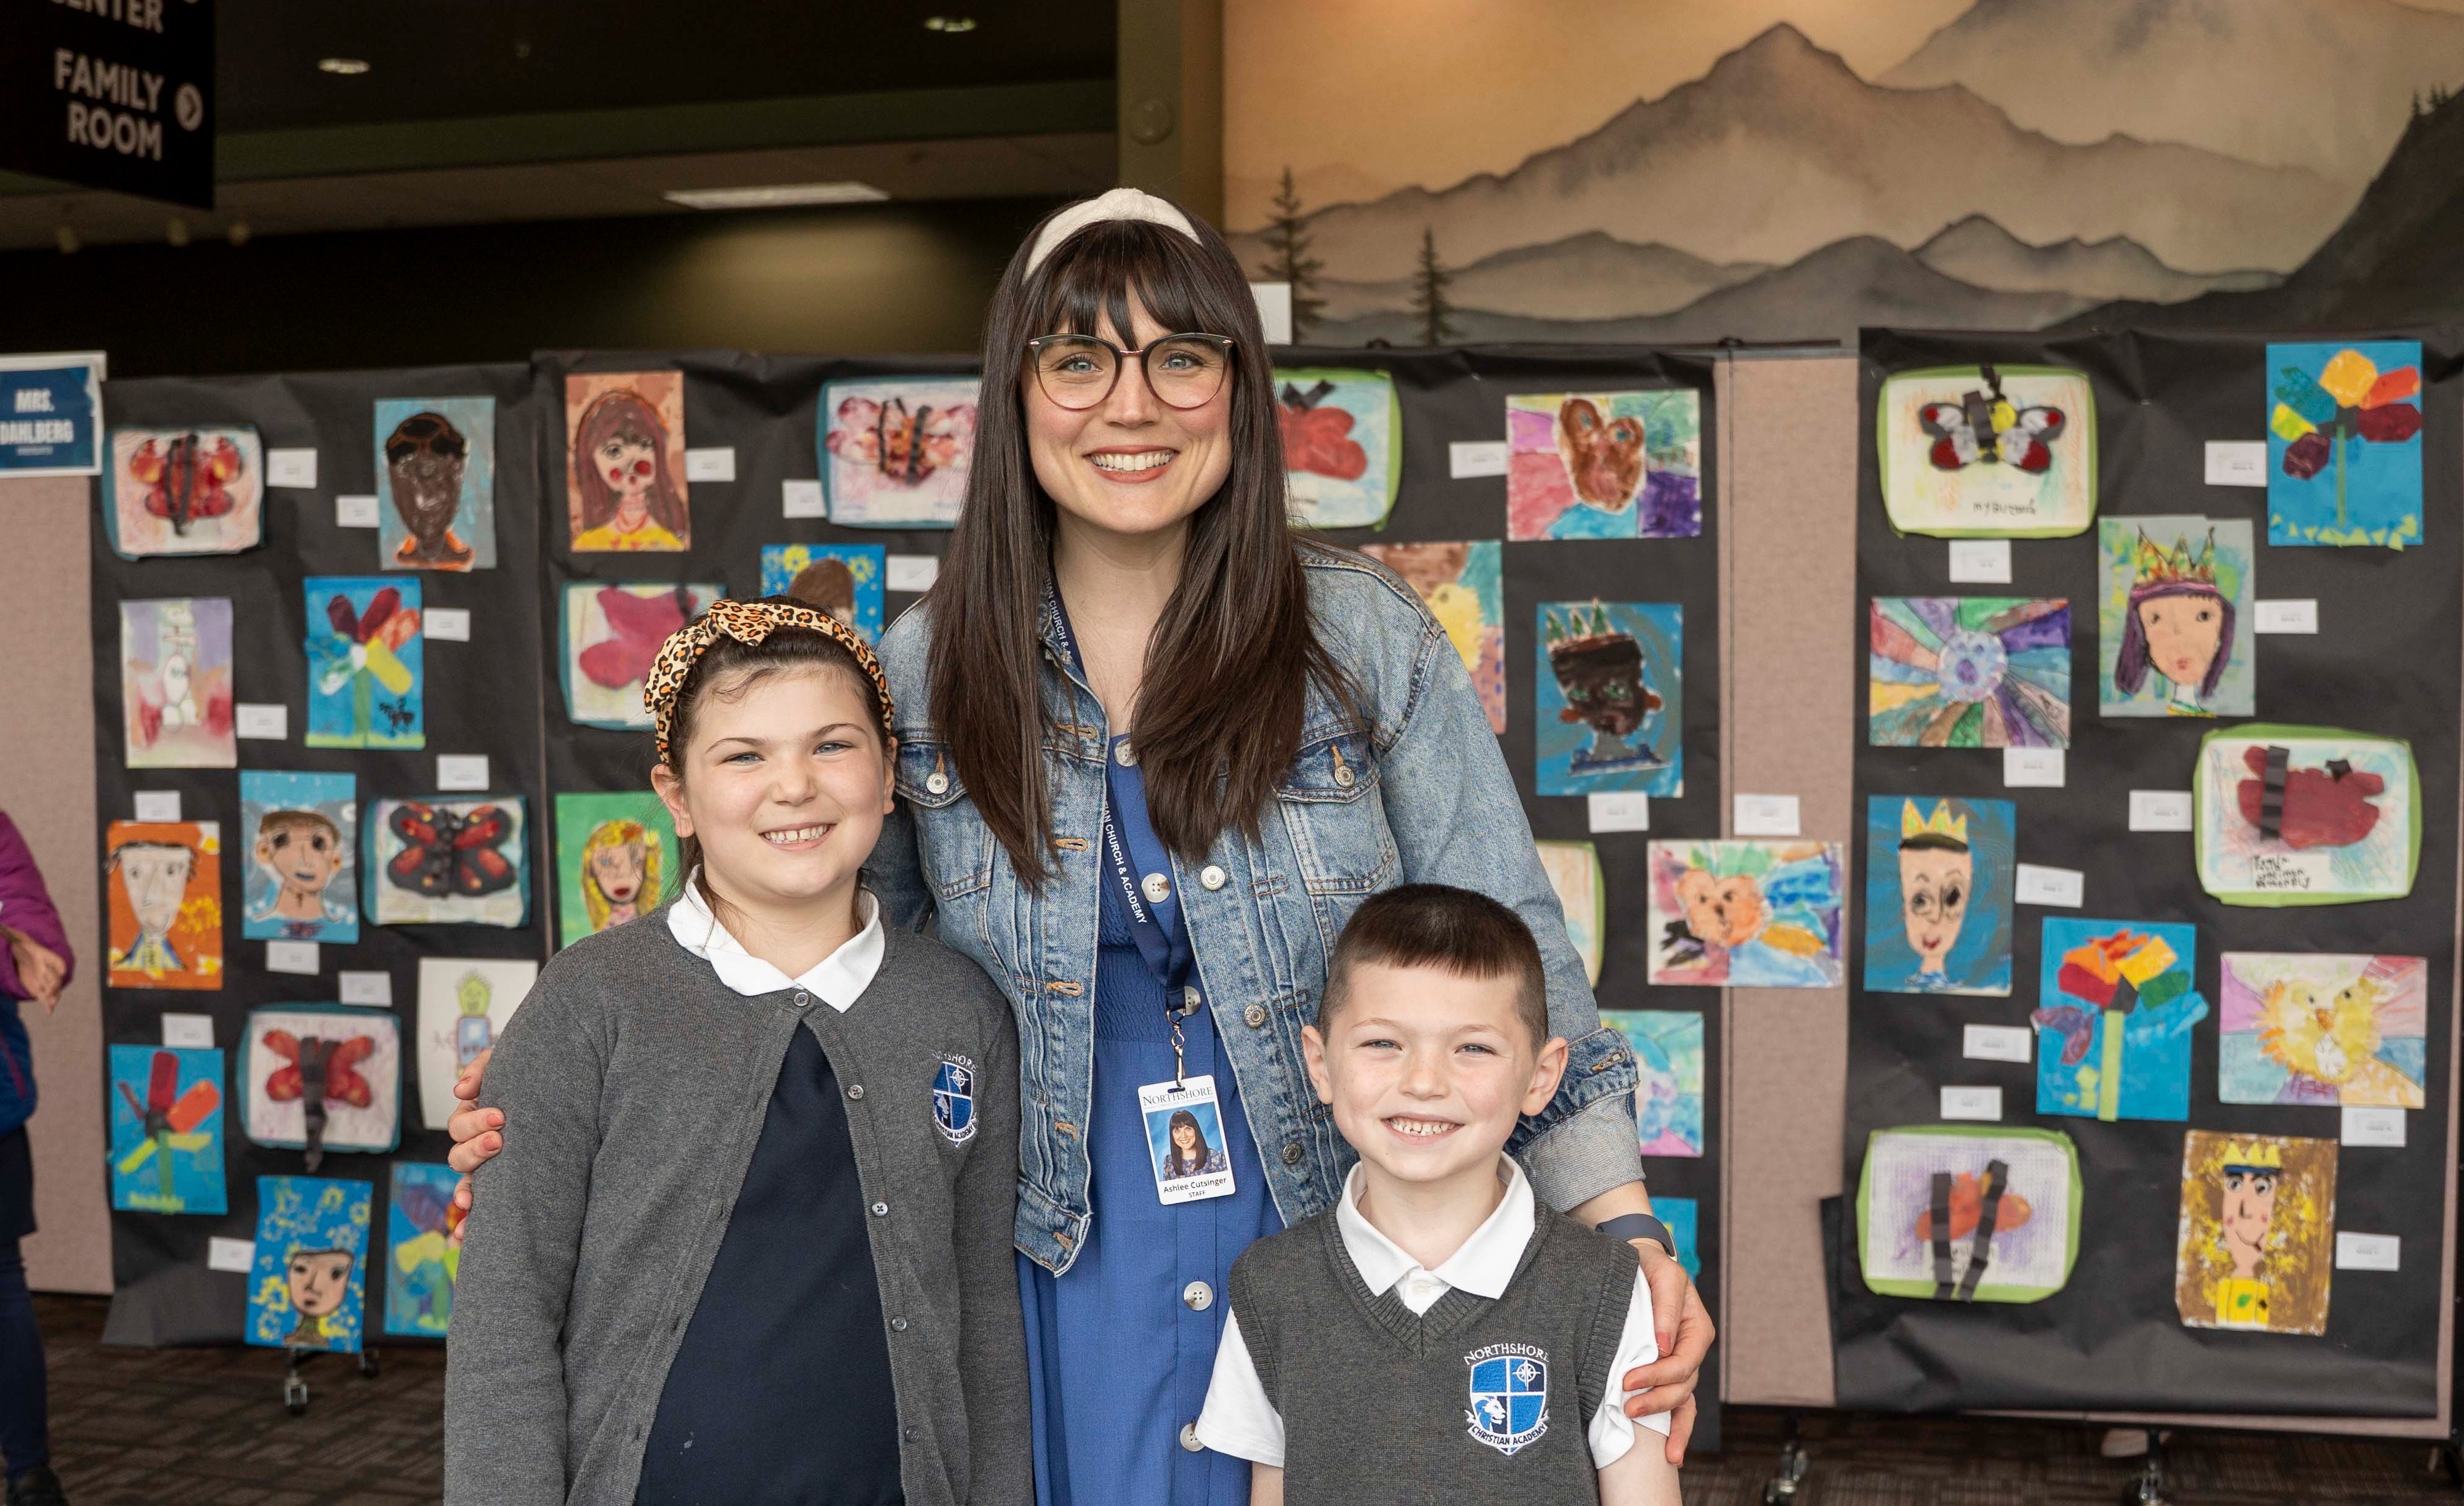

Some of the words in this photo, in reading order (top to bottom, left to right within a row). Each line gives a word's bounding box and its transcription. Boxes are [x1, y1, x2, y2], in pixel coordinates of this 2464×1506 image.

[54, 47, 164, 113] FAMILY
[68, 101, 162, 161] ROOM
[15, 388, 54, 413] MRS.
[1049, 600, 1066, 640] CHURCH
[1105, 824, 1125, 865] CHURCH
[1118, 867, 1127, 875] &
[1120, 876, 1147, 923] ACADEMY
[1142, 1087, 1214, 1106] NORTHSHORE
[1164, 1184, 1189, 1193] Ashlee
[1190, 1177, 1227, 1189] Cutsinger
[1189, 1190, 1206, 1198] STAFF
[1464, 1343, 1549, 1366] NORTHSHORE
[1472, 1425, 1509, 1445] CHRISTIAN
[1513, 1425, 1546, 1446] ACADEMY
